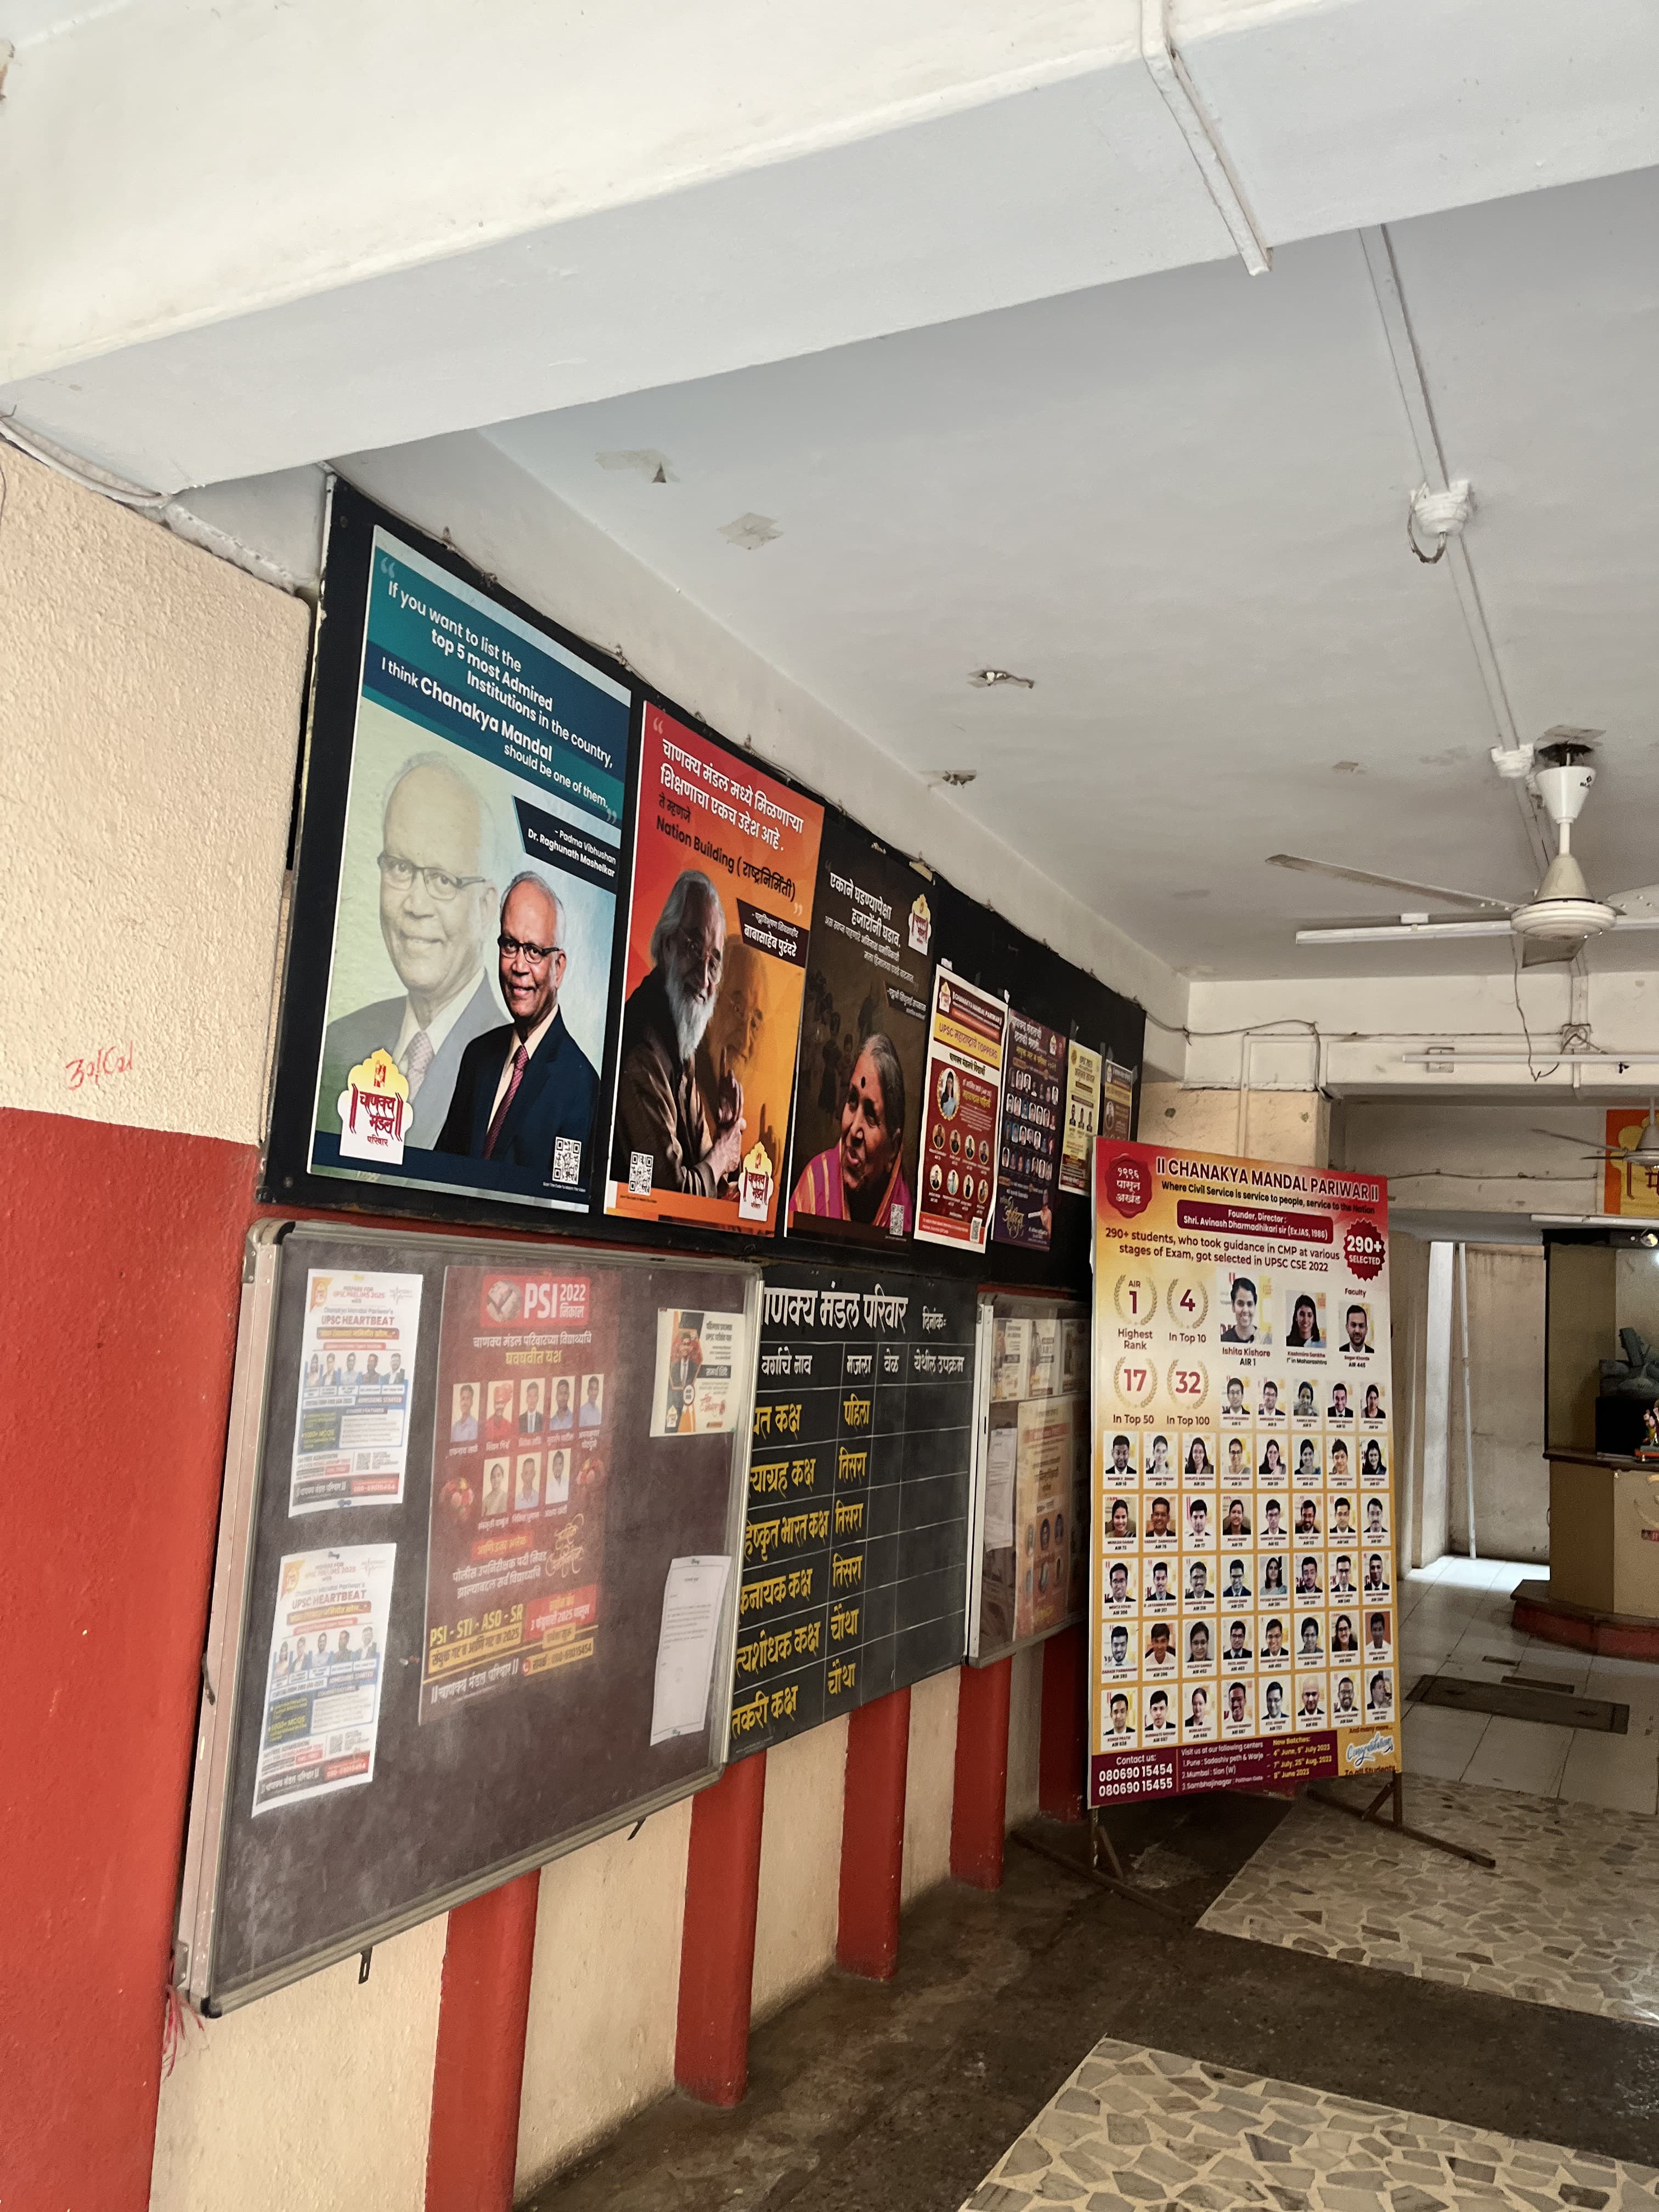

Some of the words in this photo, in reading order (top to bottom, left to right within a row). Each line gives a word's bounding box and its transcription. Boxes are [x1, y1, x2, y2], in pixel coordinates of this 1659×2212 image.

[388, 580, 398, 598] If
[400, 590, 426, 616] you
[430, 608, 463, 637] want
[465, 628, 478, 646] to
[481, 636, 499, 659] list
[501, 650, 521, 673] the
[432, 629, 454, 656] top
[456, 643, 465, 659] 5
[467, 652, 499, 681] most
[501, 672, 552, 712] Admired
[382, 657, 385, 670] I
[388, 660, 418, 688] think
[420, 677, 498, 733] Chanakya
[501, 720, 552, 761] Mandal
[467, 670, 536, 721] Institutions
[538, 712, 549, 730] in
[551, 720, 568, 740] the
[571, 733, 613, 768] country,
[504, 743, 538, 770] should
[540, 761, 551, 777] be
[554, 771, 571, 788] one
[573, 778, 583, 794] of
[583, 785, 608, 808] them.
[662, 738, 702, 777] चाणक्य
[703, 763, 729, 792] मंडल
[730, 780, 753, 808] मध्ये
[660, 763, 709, 810] शिक्षणाचा
[710, 795, 737, 825] एकच
[738, 809, 759, 837] उद्देश
[528, 828, 539, 842] Dr.
[540, 834, 579, 861] Raghunath
[580, 853, 615, 877] Mashelkar
[559, 830, 583, 849] Padma
[584, 843, 616, 865] Vibhushan
[656, 815, 691, 847] Nation
[693, 836, 735, 873] Building
[830, 872, 854, 899] एकाने
[855, 887, 892, 921] घडण्यापेक्षा
[851, 908, 882, 937] हजारोंनी
[744, 924, 777, 949] बाबासाहेब
[778, 939, 797, 956] पुरंदरे
[939, 1022, 953, 1037] UPSC
[978, 1042, 997, 1059] TOPPERS
[359, 1091, 396, 1118] चाणक्य
[369, 1113, 394, 1139] मंडल
[367, 1135, 388, 1147] परिवार
[1116, 1180, 1140, 1192] पासून
[1118, 1167, 1139, 1179] १९९६
[1169, 1159, 1249, 1184] CHANAKYA
[1251, 1170, 1308, 1192] MANDAL
[1311, 1178, 1369, 1200] PARIWAR
[1116, 1192, 1141, 1204] अखंड
[1162, 1181, 1187, 1193] Where
[1188, 1184, 1205, 1194] Civil
[1206, 1186, 1234, 1197] Service
[1243, 1190, 1269, 1201] service
[1271, 1193, 1278, 1202] to
[1279, 1195, 1305, 1207] people,
[1307, 1199, 1331, 1209] service
[1341, 1203, 1351, 1212] the
[1352, 1204, 1375, 1214] Nation
[1184, 1215, 1199, 1225] Shri.
[1200, 1218, 1227, 1228] Avinash
[1228, 1221, 1277, 1233] Dharmadhikari
[1311, 1228, 1328, 1239] 1986)
[1228, 1209, 1257, 1221] Founder,
[1105, 1227, 1128, 1238] 290+
[1131, 1231, 1176, 1245] students,
[1178, 1235, 1198, 1246] who
[1201, 1237, 1221, 1248] took
[1223, 1239, 1265, 1252] guidance
[1267, 1243, 1274, 1253] in
[1278, 1245, 1297, 1256] CMP
[1300, 1248, 1307, 1256] at
[1310, 1249, 1340, 1260] various
[1347, 1235, 1382, 1253] 290+
[1119, 1244, 1151, 1256] stages
[1154, 1247, 1164, 1256] of
[1166, 1248, 1193, 1261] Exam,
[1197, 1251, 1211, 1262] got
[1214, 1253, 1251, 1265] selected
[1254, 1255, 1262, 1266] in
[1265, 1257, 1288, 1268] UPSC
[1290, 1260, 1306, 1269] CSE
[1309, 1262, 1329, 1272] 2022
[1349, 1255, 1380, 1265] SELECTED
[524, 1283, 558, 1319] PSI
[560, 1284, 586, 1301] 2022
[1129, 1290, 1137, 1314] 1
[1180, 1289, 1196, 1311] 4
[1345, 1288, 1366, 1298] Faculty
[321, 1315, 341, 1325] UPSC
[342, 1316, 395, 1325] HEARTBEAT
[560, 1302, 584, 1318] निकाल
[820, 1281, 860, 1330] मंडल
[863, 1283, 909, 1334] परिवार
[473, 1336, 501, 1348] चाणक्य
[503, 1333, 522, 1347] मंडल
[523, 1331, 558, 1346] परिवारच्या
[1118, 1328, 1153, 1340] Highest
[1124, 1340, 1147, 1350] Rank
[1169, 1332, 1177, 1342] In
[1180, 1333, 1196, 1344] Top
[1197, 1334, 1206, 1343] 10
[545, 1350, 562, 1363] यश
[794, 1355, 812, 1375] नाव
[847, 1355, 872, 1378] मजला
[884, 1348, 899, 1373] वेळ
[1222, 1347, 1243, 1356] Ishita
[1244, 1348, 1271, 1357] Kishore
[1124, 1369, 1147, 1391] 17
[1175, 1372, 1201, 1393] 32
[775, 1403, 802, 1440] कक्ष
[843, 1393, 871, 1431] पहिला
[1113, 1414, 1122, 1423] In
[1124, 1415, 1141, 1425] Top
[1143, 1415, 1154, 1424] 50
[1166, 1415, 1175, 1424] In
[1177, 1417, 1193, 1426] Top
[1195, 1417, 1210, 1425] 100
[791, 1458, 816, 1492] कक्ष
[839, 1446, 867, 1483] तिसरा
[781, 1514, 808, 1548] भारत
[809, 1510, 830, 1545] कक्ष
[835, 1499, 864, 1536] तिसरा
[788, 1568, 813, 1601] कक्ष
[832, 1553, 863, 1588] तिसरा
[794, 1621, 821, 1657] कक्ष
[771, 1685, 799, 1721] कक्ष
[1099, 1767, 1139, 1782] 080690
[1142, 1763, 1172, 1776] 15454
[1116, 1754, 1145, 1766] Contact
[1099, 1781, 1139, 1797] 080690
[1142, 1778, 1172, 1792] 15455
